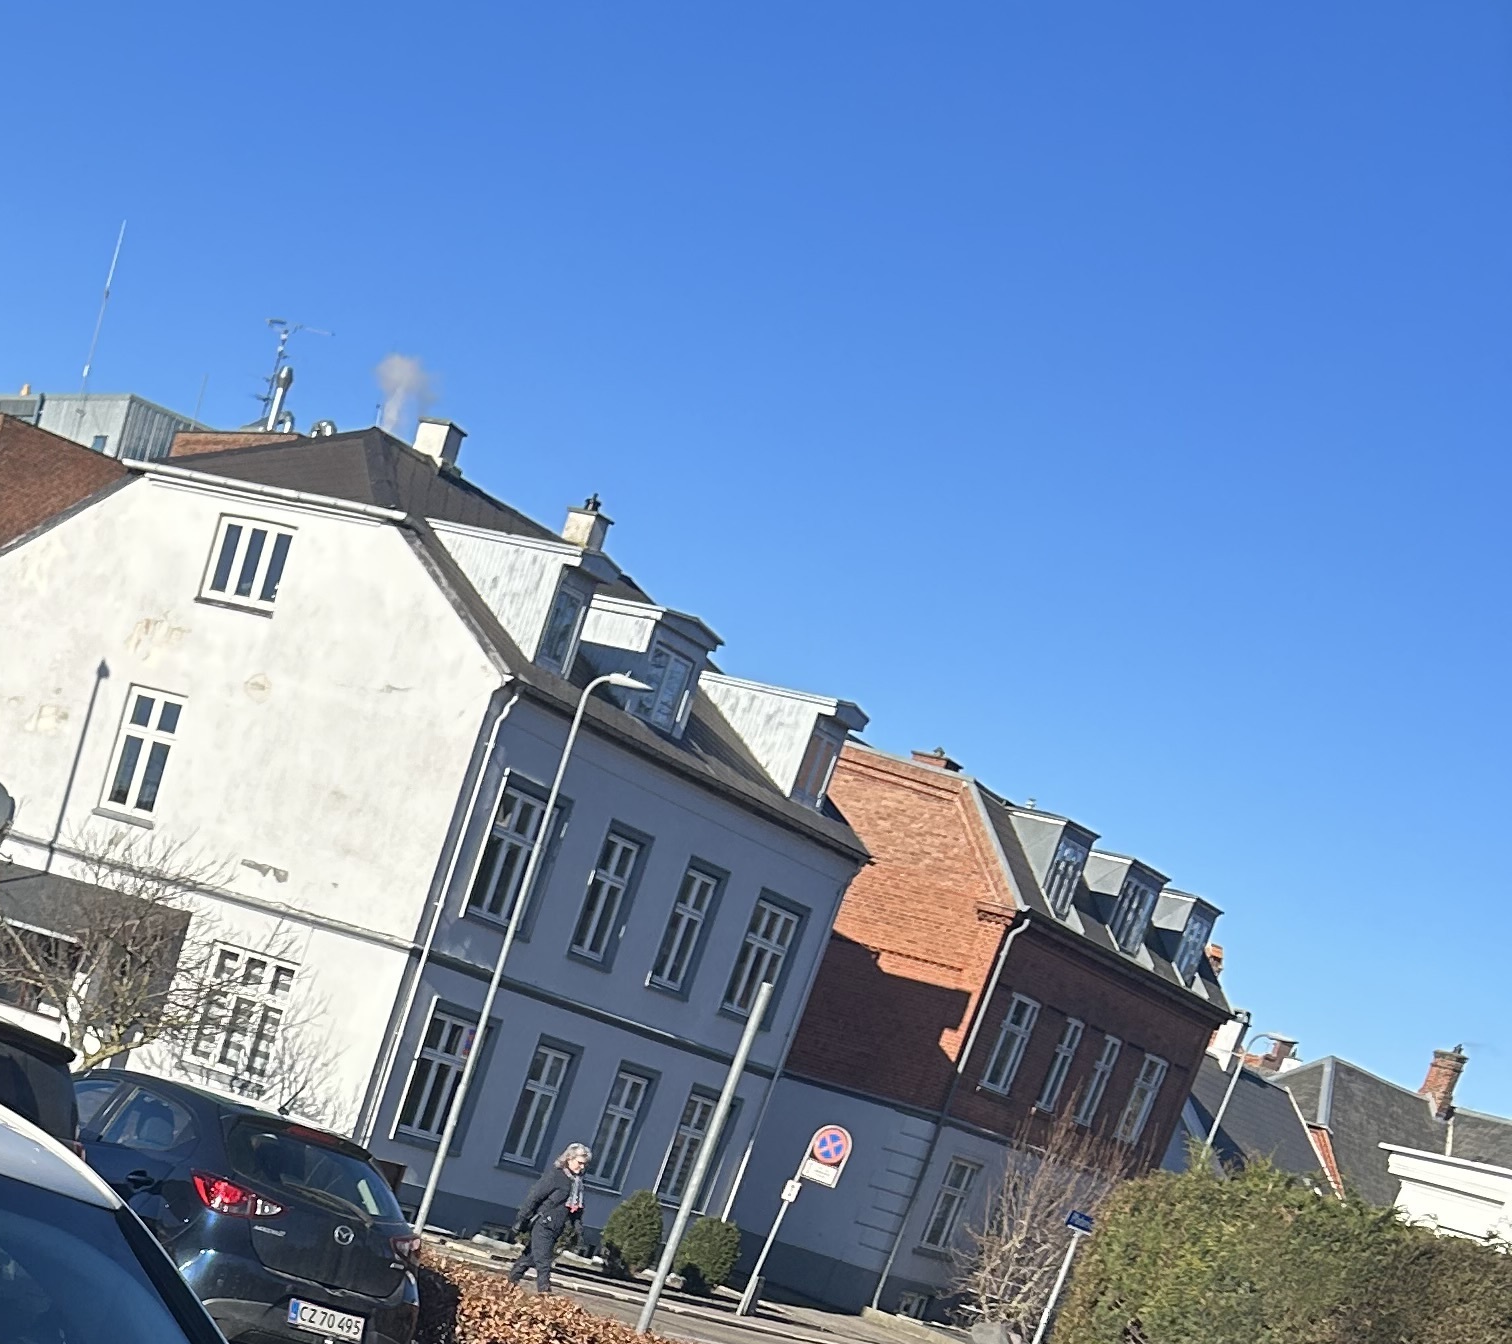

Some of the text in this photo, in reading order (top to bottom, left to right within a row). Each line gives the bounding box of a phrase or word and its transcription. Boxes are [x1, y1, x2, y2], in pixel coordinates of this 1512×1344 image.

[300, 1306, 361, 1335] CZ 70 495
